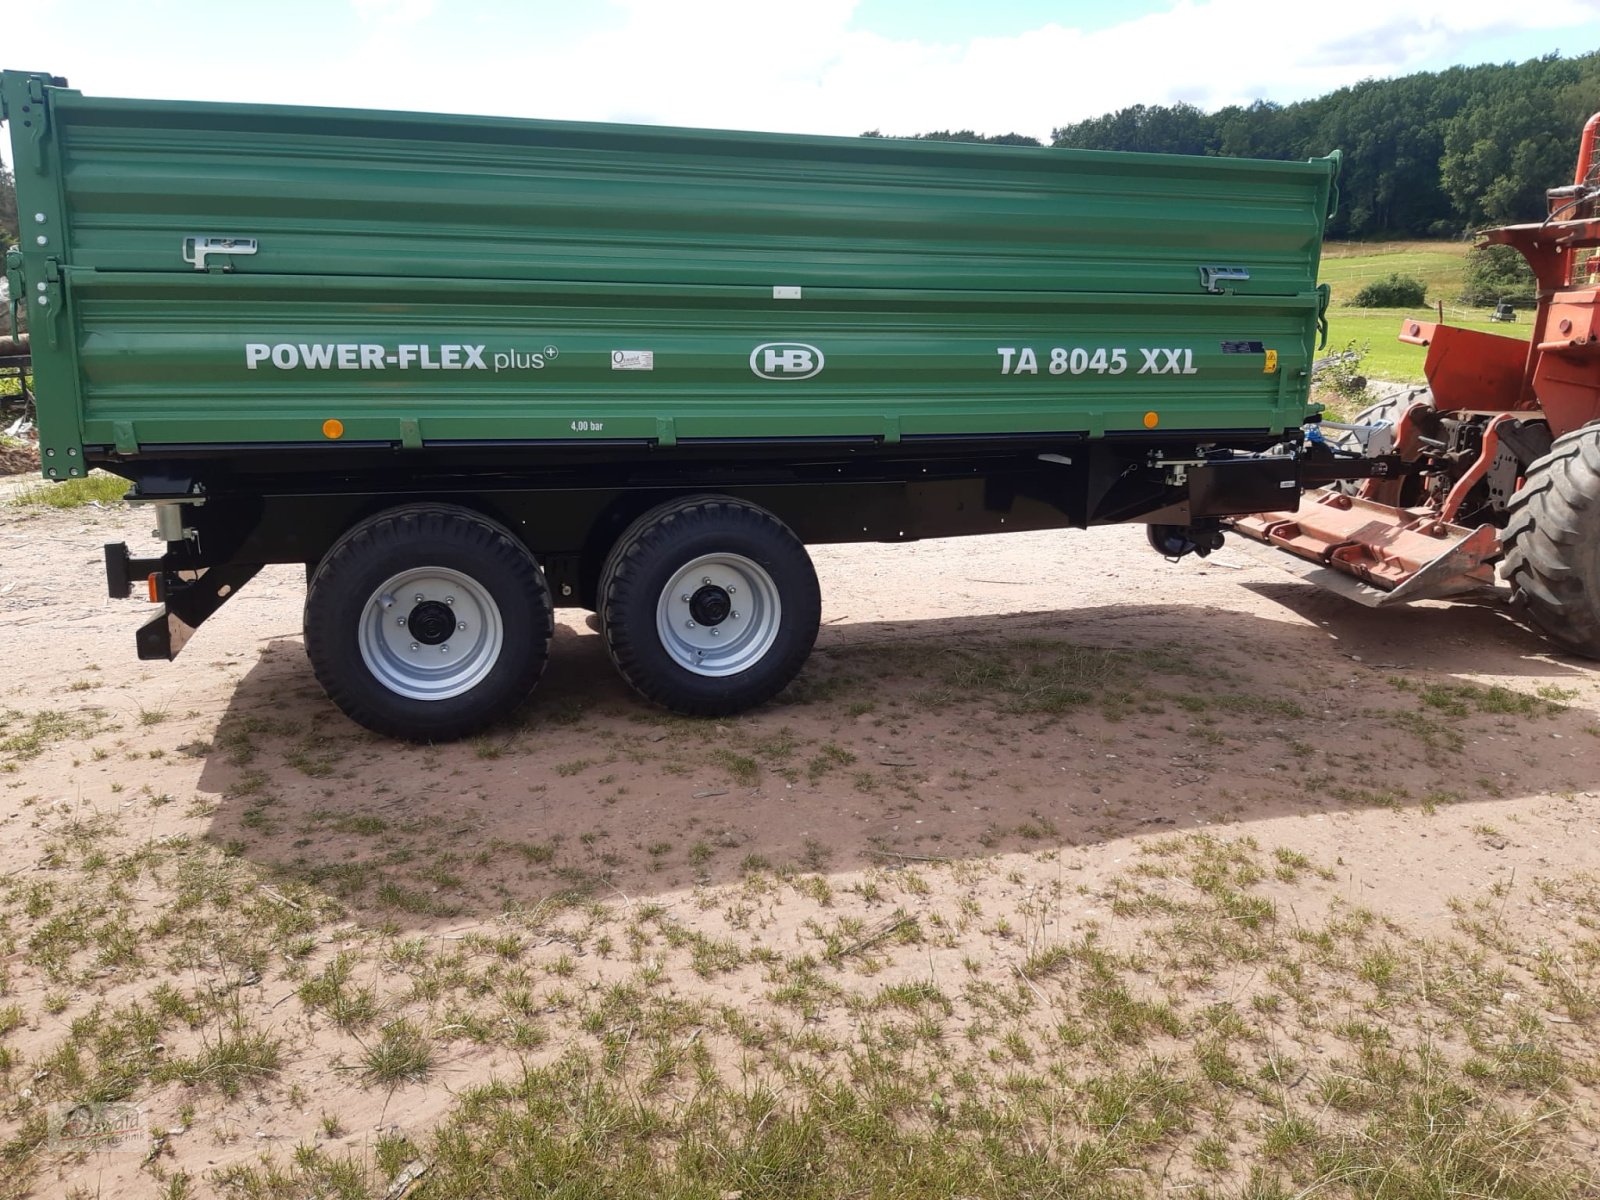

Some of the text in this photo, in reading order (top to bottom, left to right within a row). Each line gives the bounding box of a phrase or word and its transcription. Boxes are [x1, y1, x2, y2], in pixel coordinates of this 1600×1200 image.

[245, 343, 488, 371] POWER-FLEX
[764, 349, 814, 373] HB
[997, 347, 1199, 375] TA 8045 XXL
[570, 421, 604, 432] 4,00 bar
